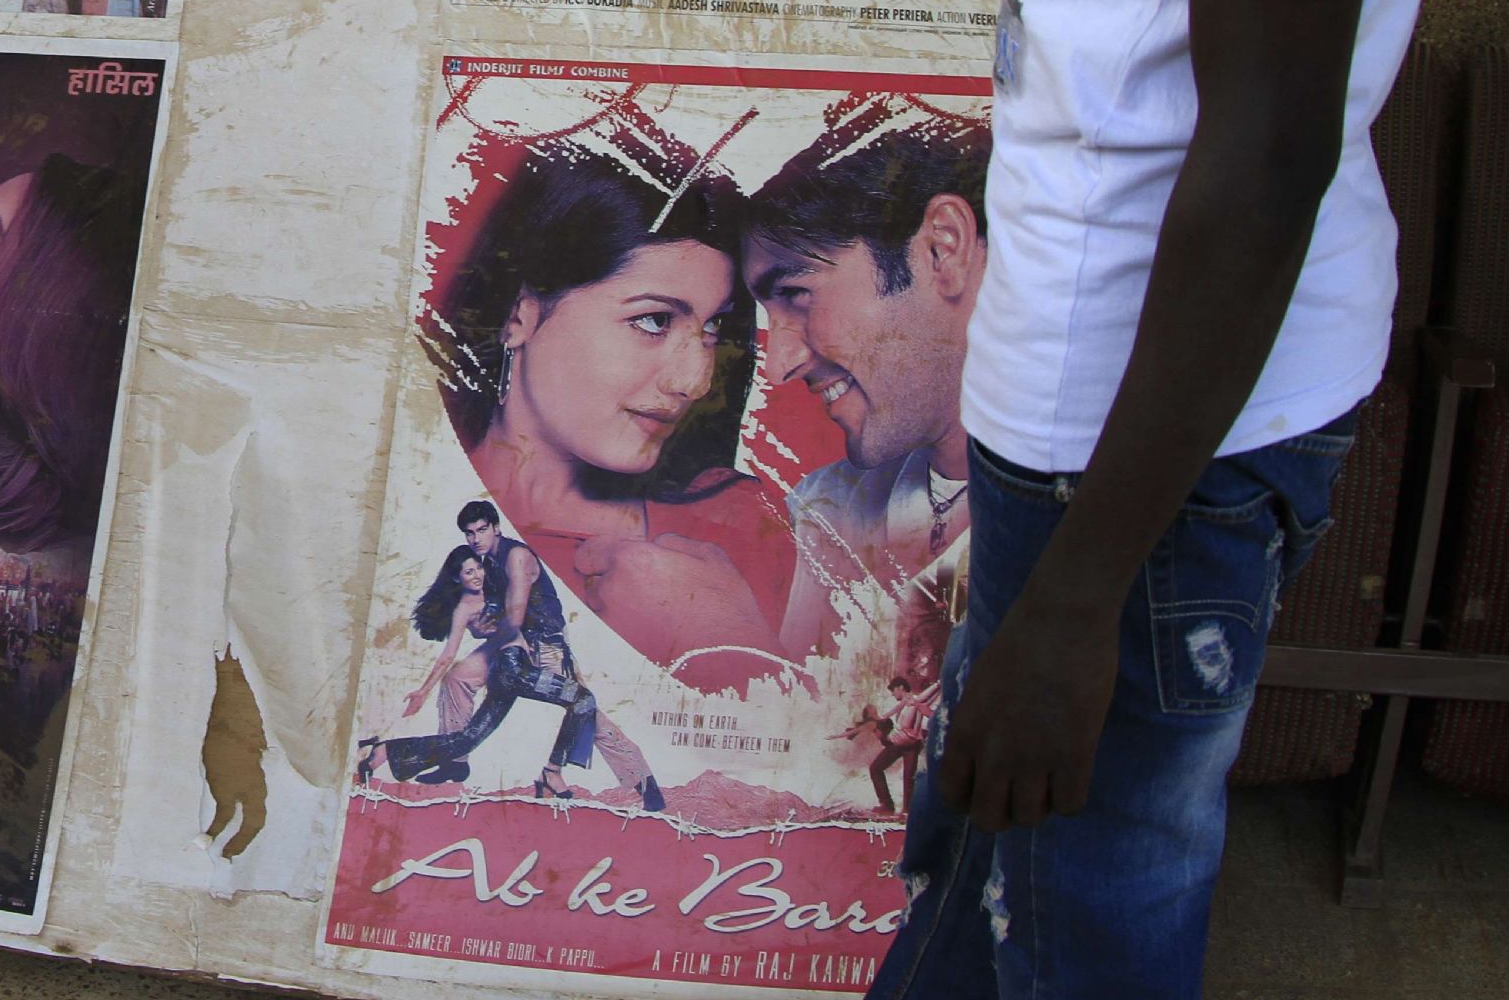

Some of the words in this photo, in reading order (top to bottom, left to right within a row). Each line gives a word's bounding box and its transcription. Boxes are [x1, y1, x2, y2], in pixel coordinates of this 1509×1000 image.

[710, 0, 780, 16] SHRIVASTAVA
[782, 3, 857, 20] CINEMATOGRAPHY
[859, 6, 890, 21] PETER
[892, 8, 934, 23] PERIERA
[937, 10, 967, 25] ACTION
[67, 61, 159, 96] हासिल
[467, 62, 524, 75] INDERJIT
[529, 63, 566, 76] FILMS
[570, 65, 629, 79] COMBINE
[651, 711, 689, 728] NOTHING
[693, 713, 705, 729] ON
[671, 731, 690, 747] CAN
[722, 734, 763, 752] BETWEEN
[767, 737, 791, 753] THEM
[371, 837, 544, 907] Ab
[567, 856, 656, 917] ke
[333, 922, 355, 941] ANU
[652, 949, 661, 972] A
[672, 951, 712, 976] FILM
[721, 954, 742, 978] BY
[755, 950, 796, 981] RAJ
[809, 953, 877, 986] KANWA
